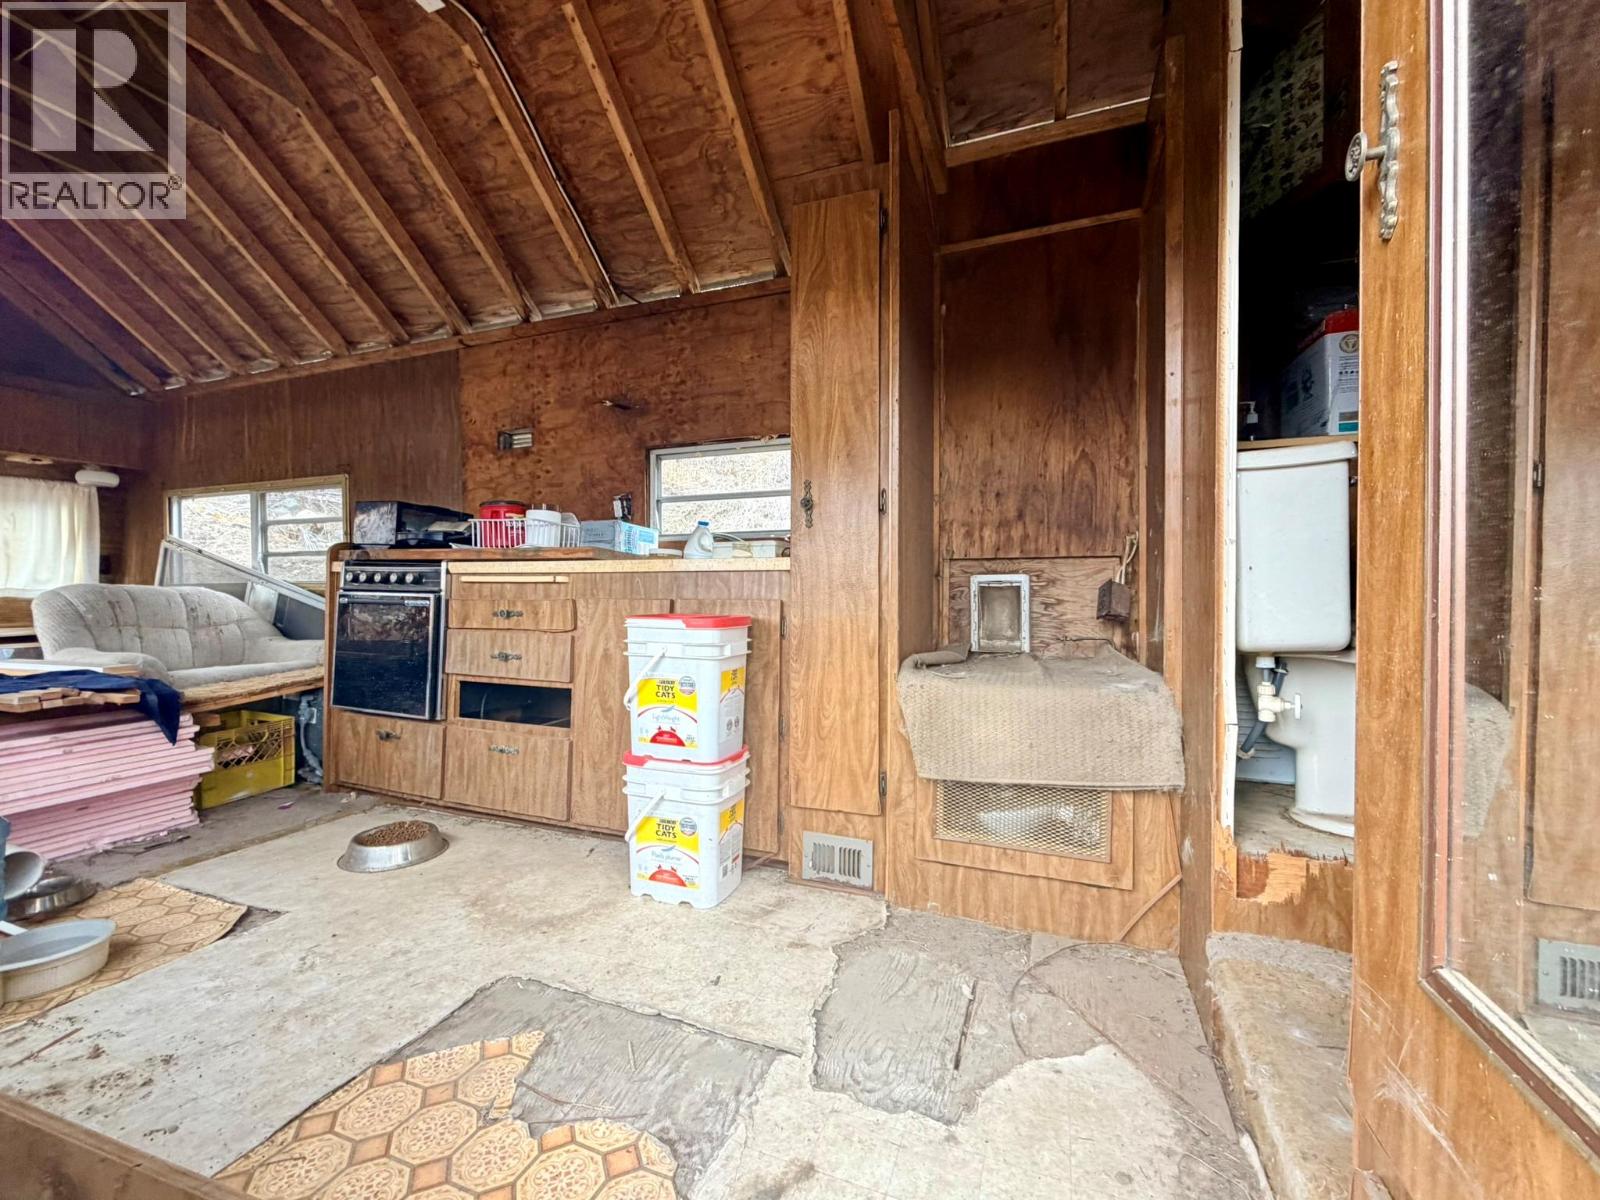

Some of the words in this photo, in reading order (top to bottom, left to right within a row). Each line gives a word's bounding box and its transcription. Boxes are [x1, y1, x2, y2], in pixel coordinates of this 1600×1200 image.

[656, 684, 675, 692] TIDY
[655, 691, 676, 699] CATS
[656, 823, 676, 831] TIDY
[655, 830, 677, 839] CATS
